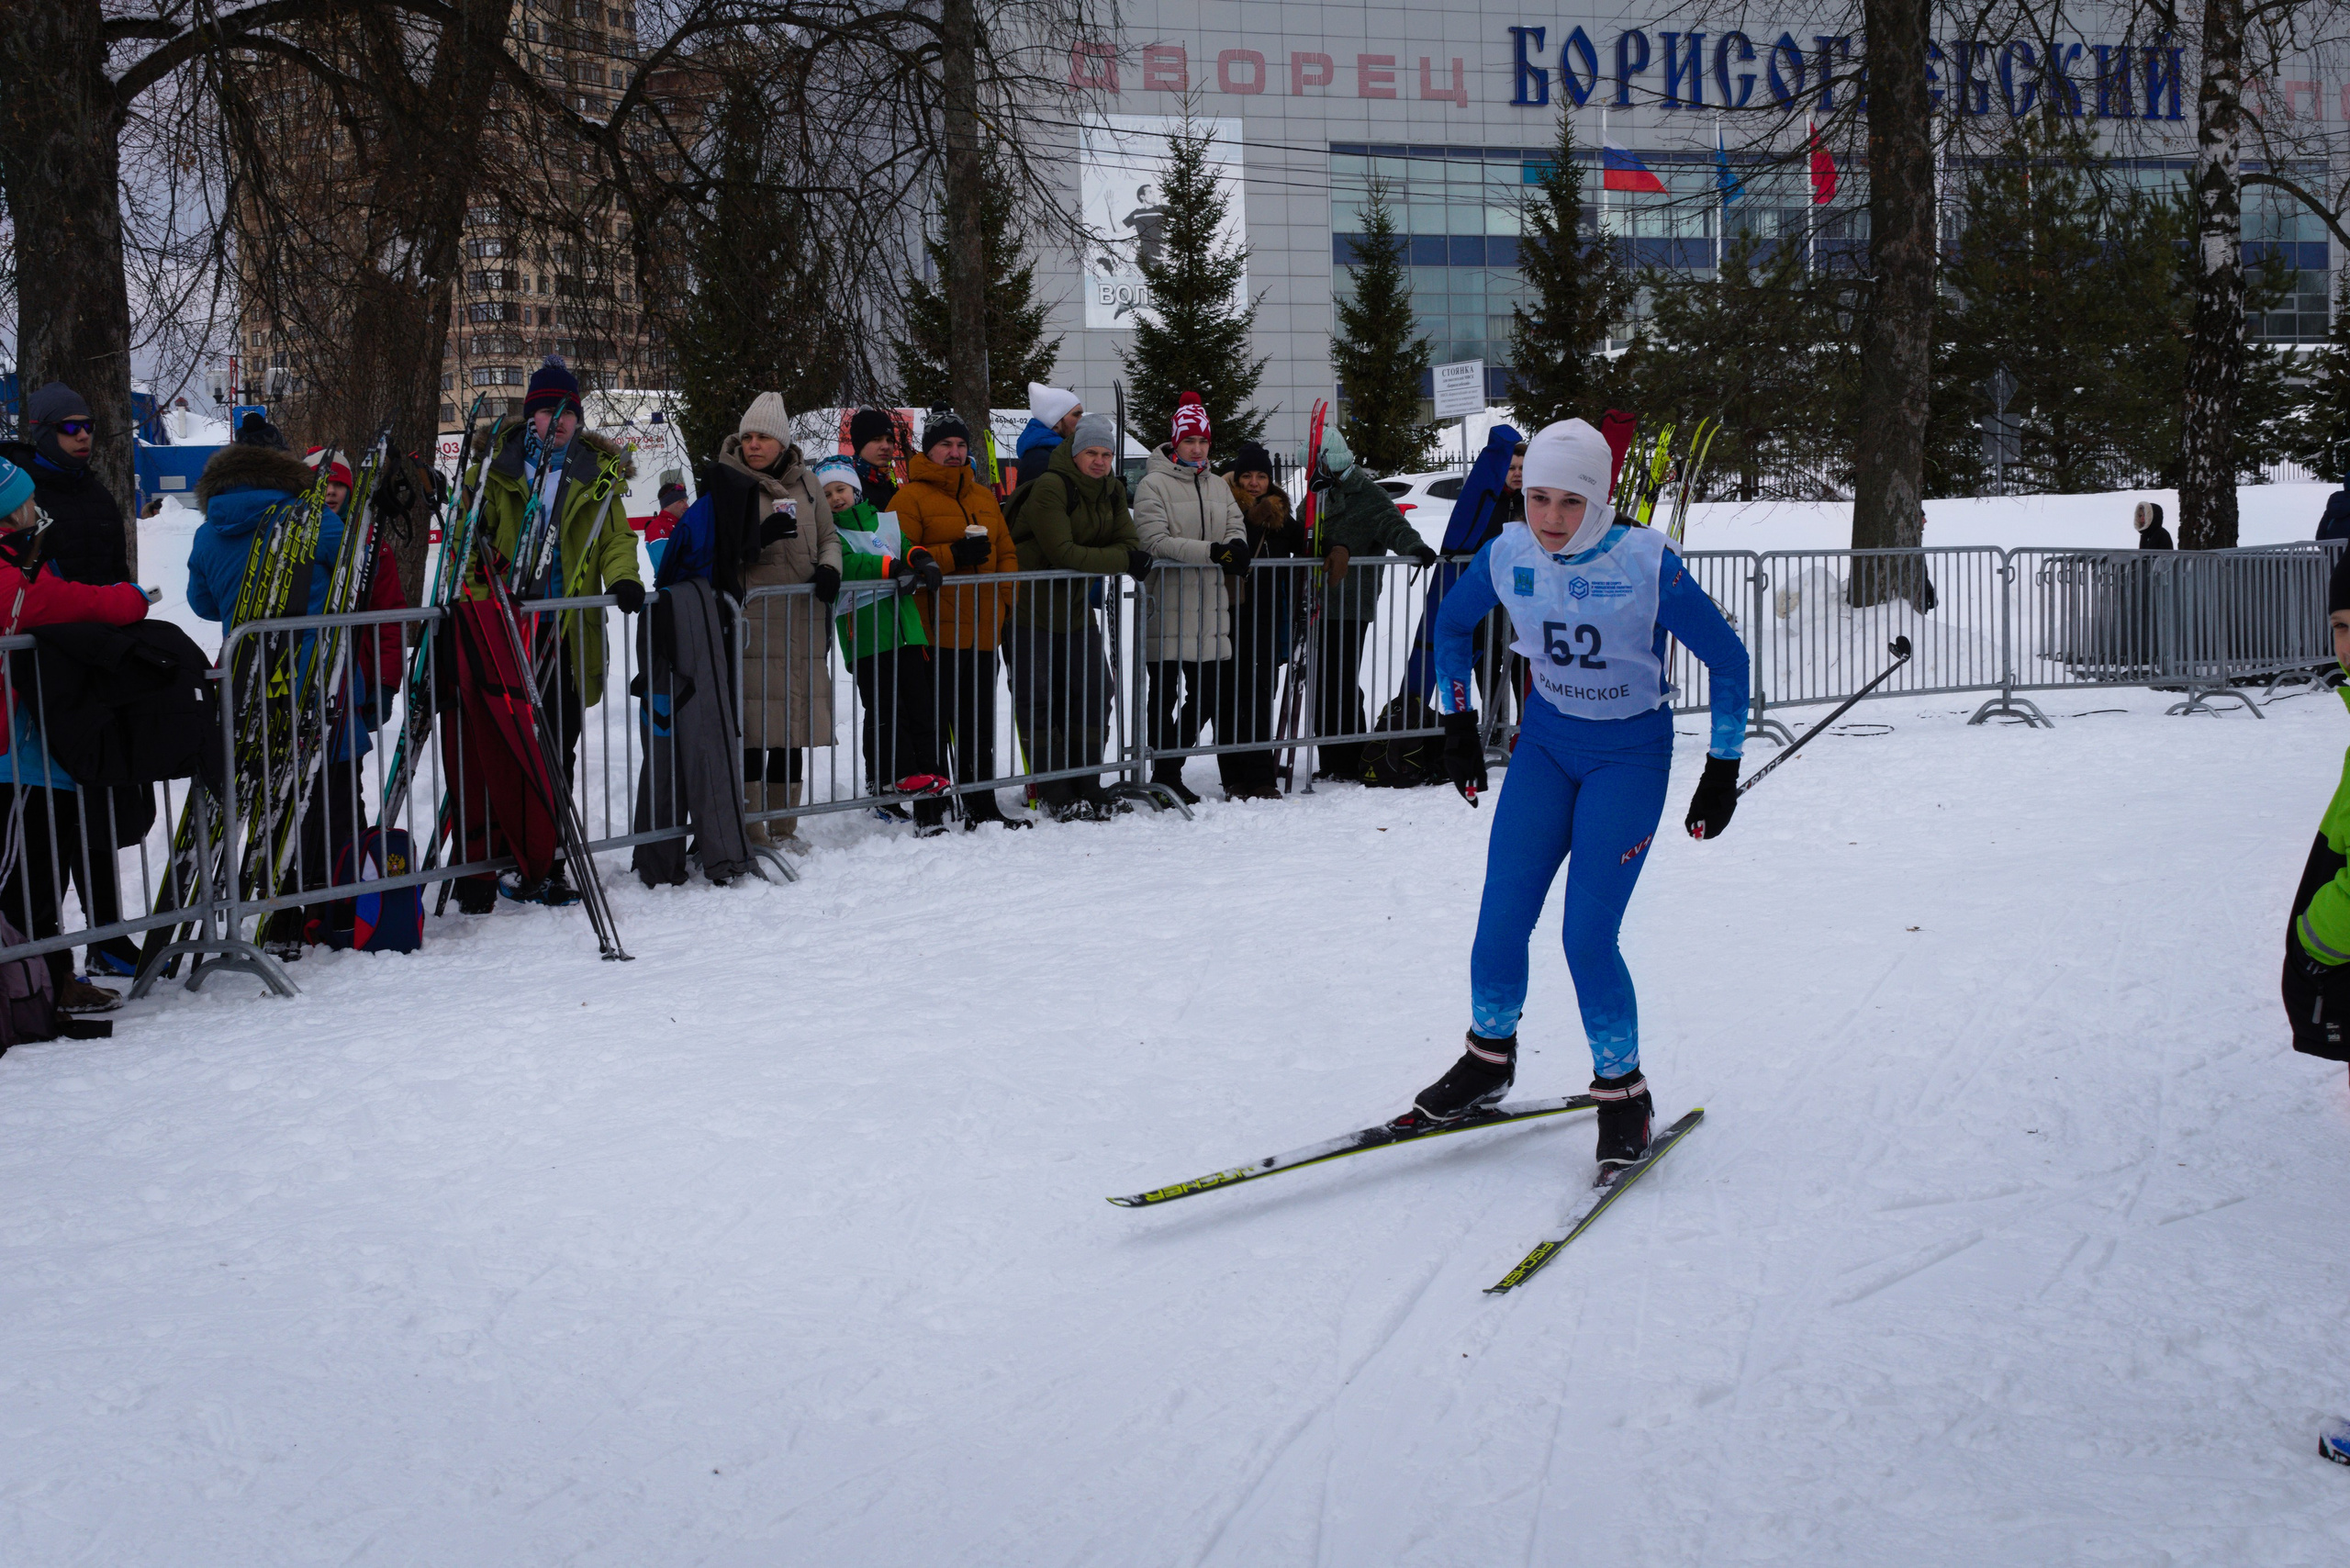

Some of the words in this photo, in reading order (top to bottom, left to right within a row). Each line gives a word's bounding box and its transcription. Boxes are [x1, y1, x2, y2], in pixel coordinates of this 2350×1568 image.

[1068, 42, 1469, 108] ДВОРЕЦ
[1508, 25, 2187, 121] БОРИСОГБСКИЙ
[1442, 365, 1473, 376] СТОЯНКА
[442, 442, 460, 454] 03
[1543, 621, 1606, 670] 52
[1539, 673, 1630, 700] РАМЕНСКОЕ
[1620, 834, 1652, 865] KV+
[1146, 1166, 1254, 1203] ISCHER
[1498, 1241, 1555, 1287] FISCHER
